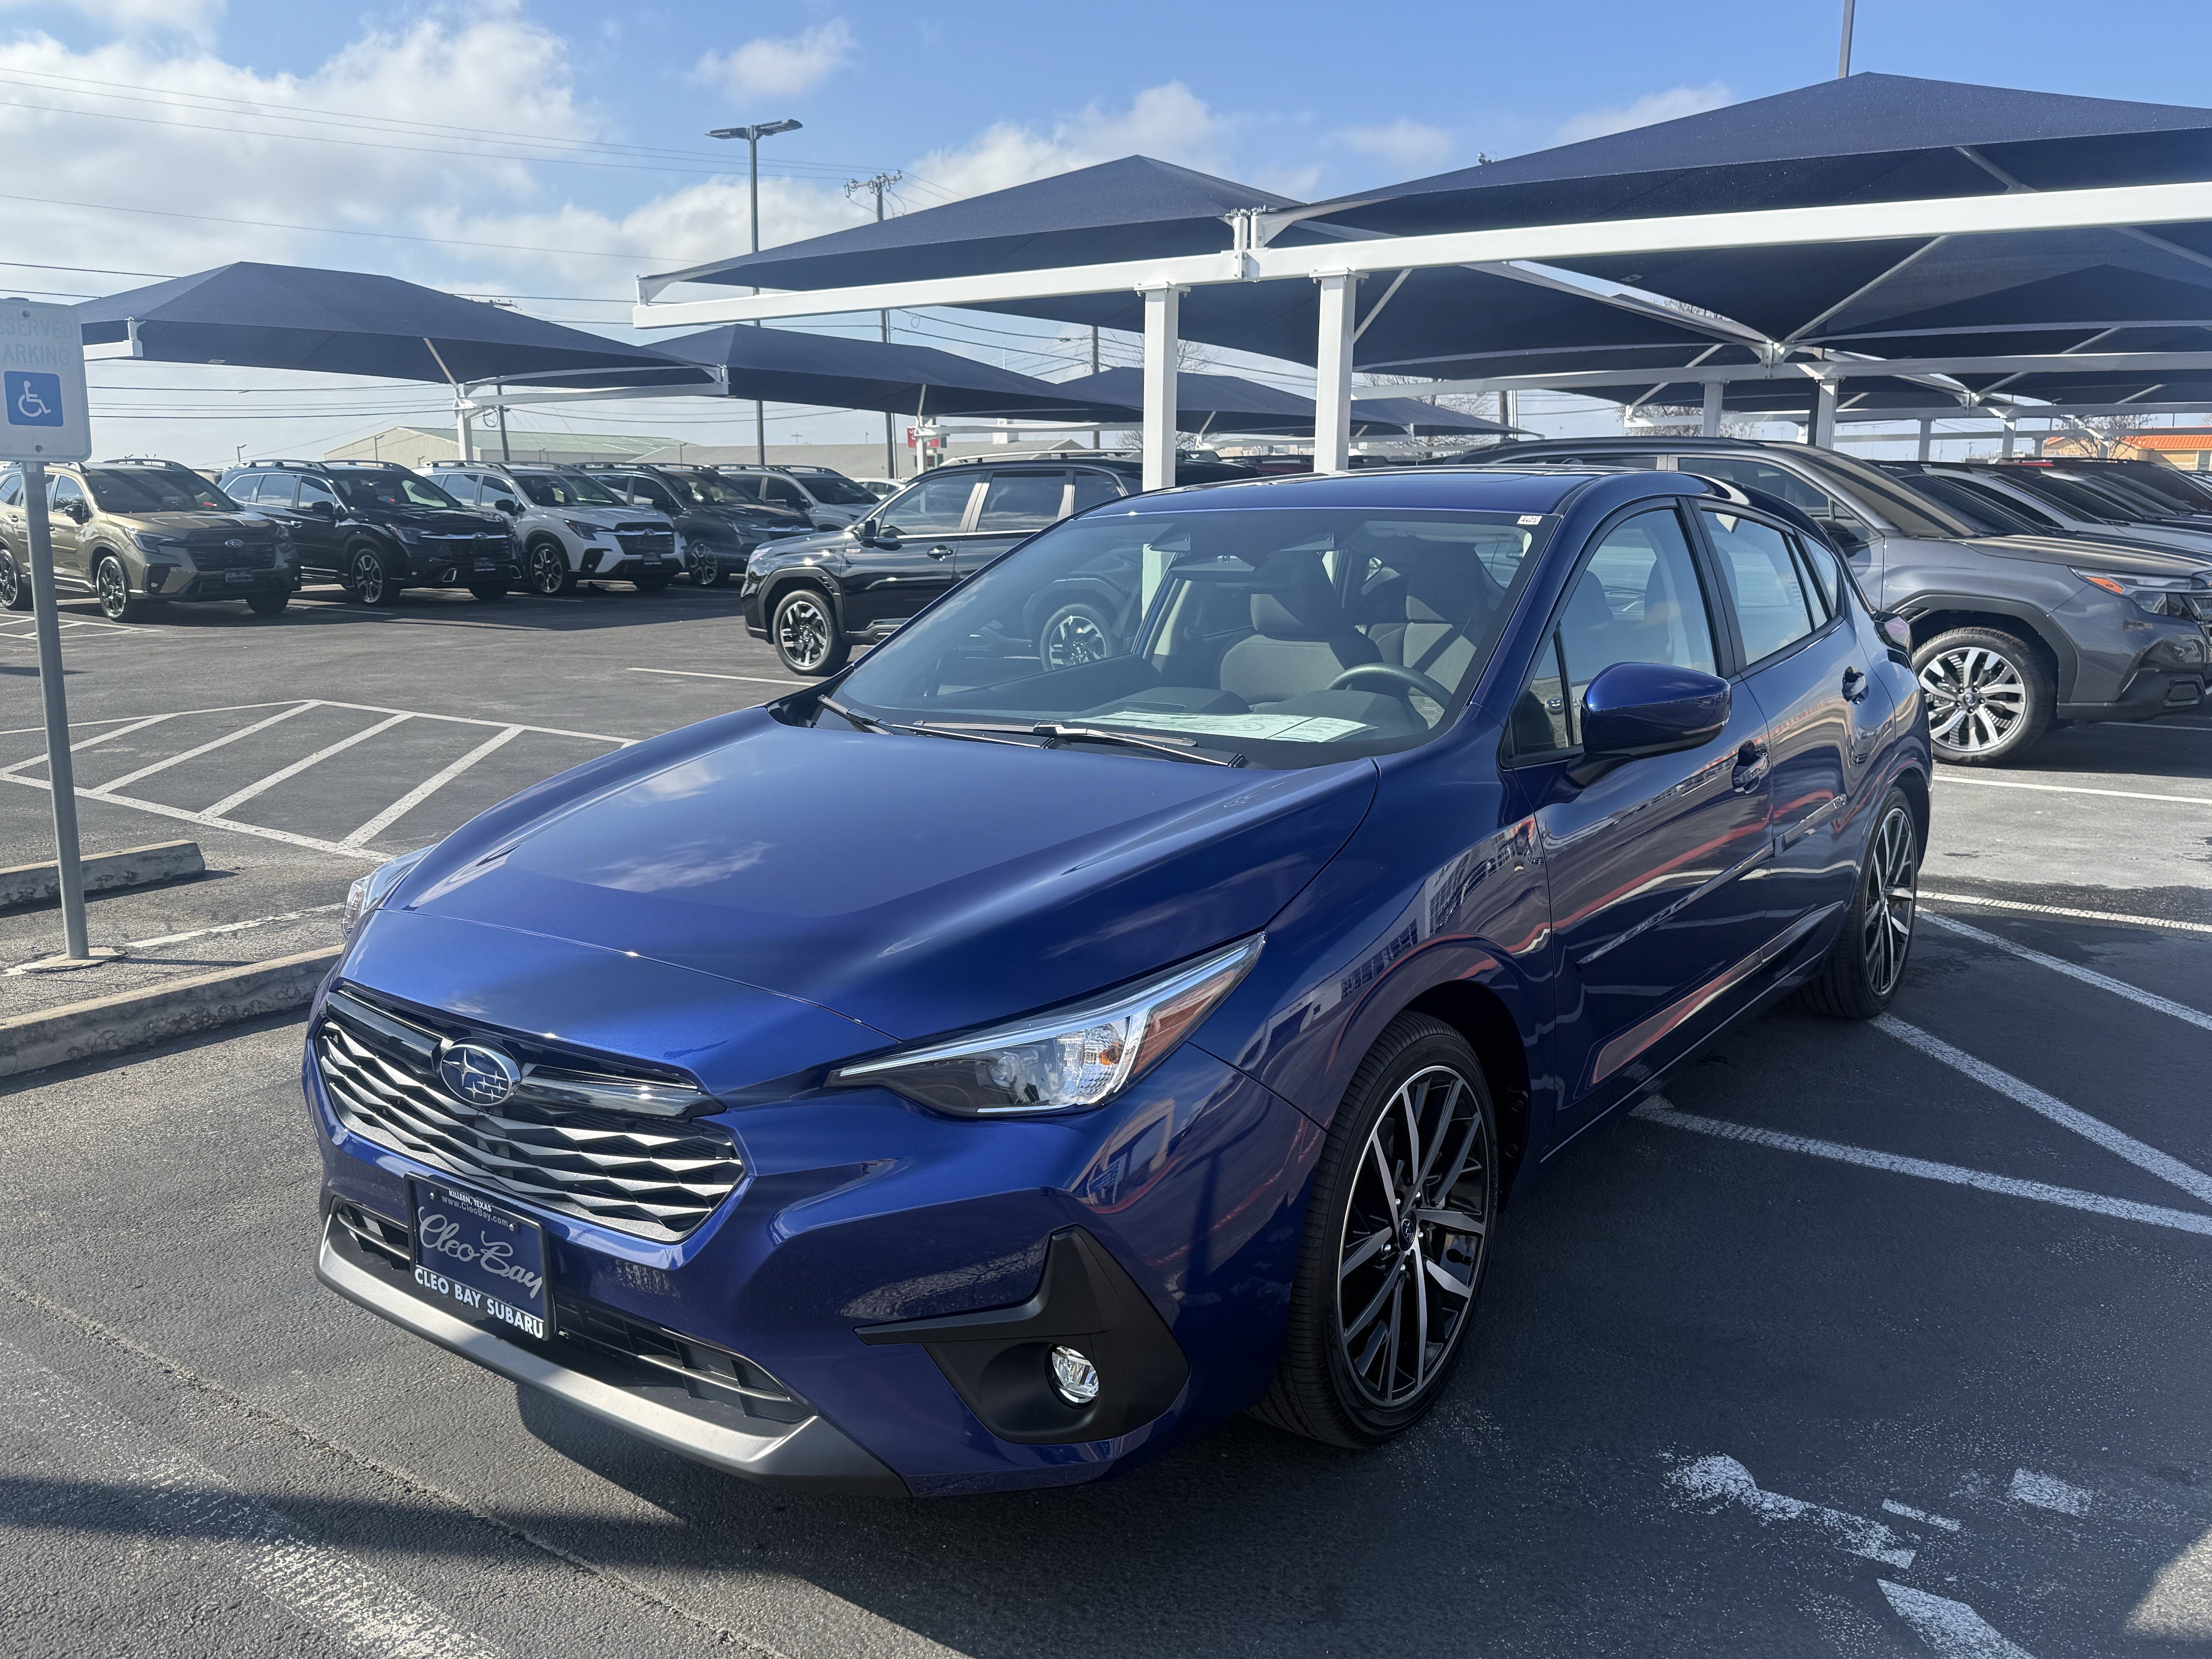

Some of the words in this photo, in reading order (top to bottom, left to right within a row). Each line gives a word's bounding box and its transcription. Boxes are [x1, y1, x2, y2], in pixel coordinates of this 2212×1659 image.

[0, 316, 74, 339] SERVED
[3, 343, 70, 366] ARKING
[441, 1195, 508, 1227] www.CleoBay.com
[448, 1189, 472, 1206] KILLEEN,
[473, 1199, 492, 1212] TEXAS
[418, 1206, 480, 1262] Cleo
[480, 1231, 543, 1299] Bay
[415, 1268, 449, 1294] CLEO
[455, 1284, 481, 1308] BAY
[487, 1300, 543, 1339] SUBARU
